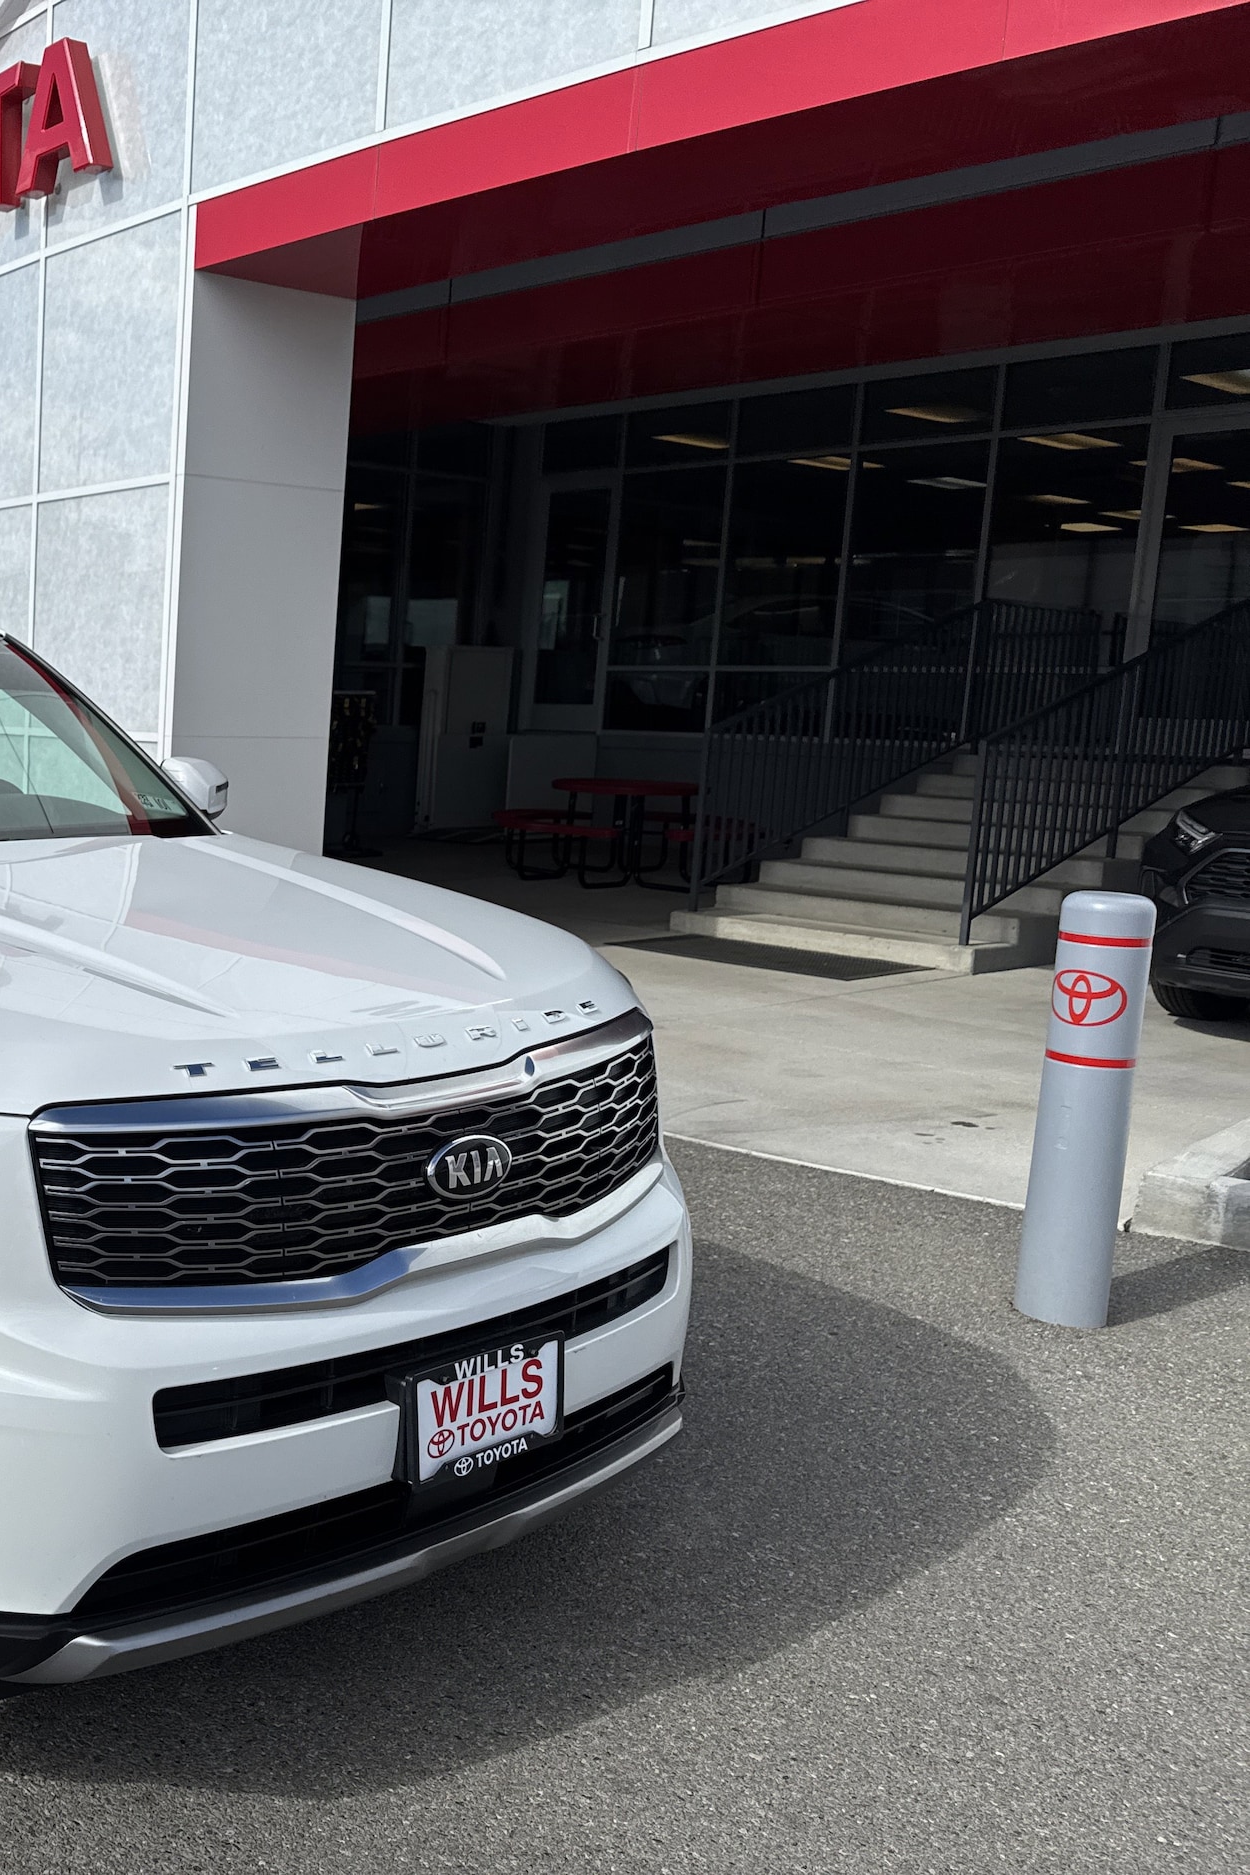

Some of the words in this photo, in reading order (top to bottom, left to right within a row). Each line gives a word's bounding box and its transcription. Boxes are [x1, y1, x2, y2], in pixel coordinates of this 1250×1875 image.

[173, 999, 599, 1078] TELLURIDE
[445, 1146, 504, 1189] KIA
[454, 1343, 525, 1380] WILLS
[430, 1358, 543, 1428] WILLS
[456, 1400, 545, 1446] TOYOTA
[475, 1436, 529, 1468] TOYOTA
